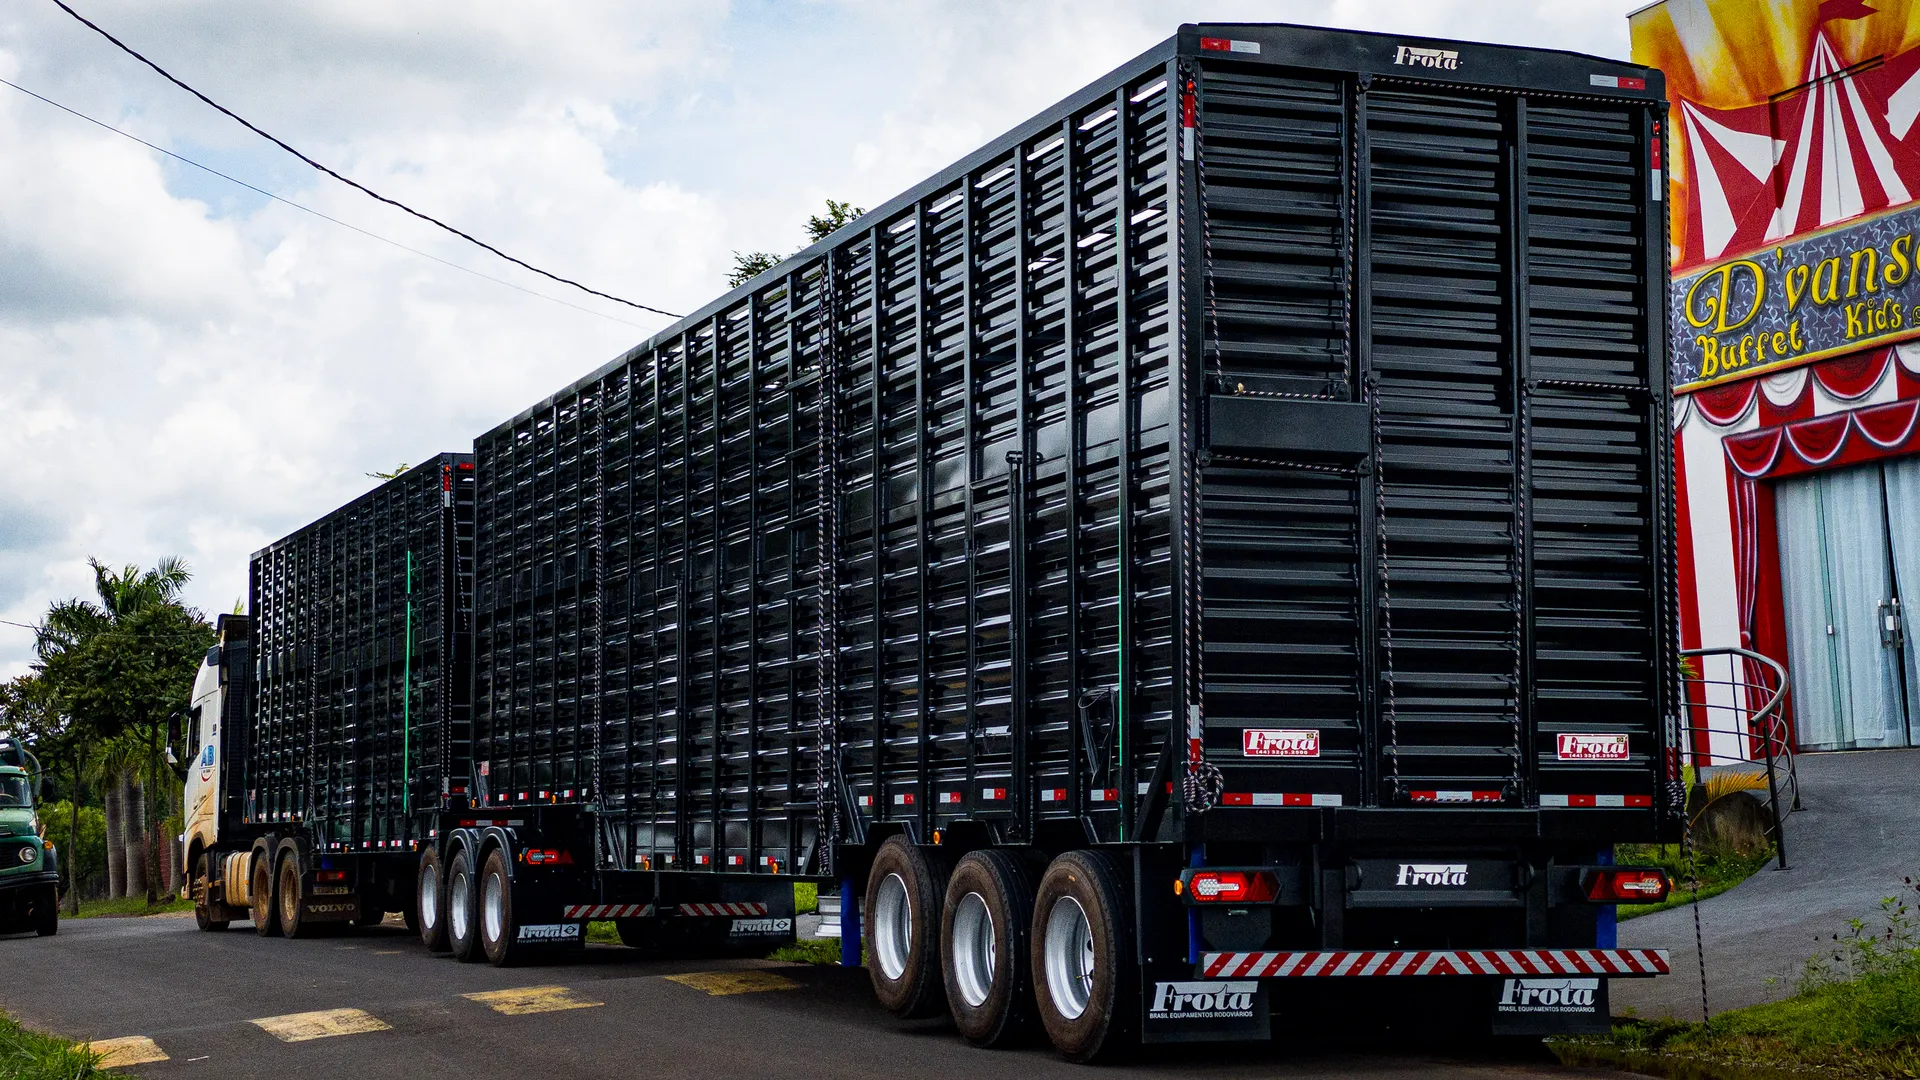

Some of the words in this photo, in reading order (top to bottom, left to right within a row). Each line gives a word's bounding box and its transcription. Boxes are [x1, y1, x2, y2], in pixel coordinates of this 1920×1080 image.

[1394, 45, 1459, 70] Frota
[1685, 234, 1920, 334] D'vans
[1696, 319, 1803, 378] Buffet
[1843, 298, 1904, 340] Kids
[1247, 732, 1317, 750] Frota
[1561, 736, 1626, 754] Frota
[1396, 864, 1468, 886] Frota
[307, 904, 356, 913] VOLVO
[517, 925, 561, 938] Frota
[730, 919, 773, 932] Frota
[1149, 981, 1259, 1011] Frota
[1498, 978, 1600, 1005] Frota
